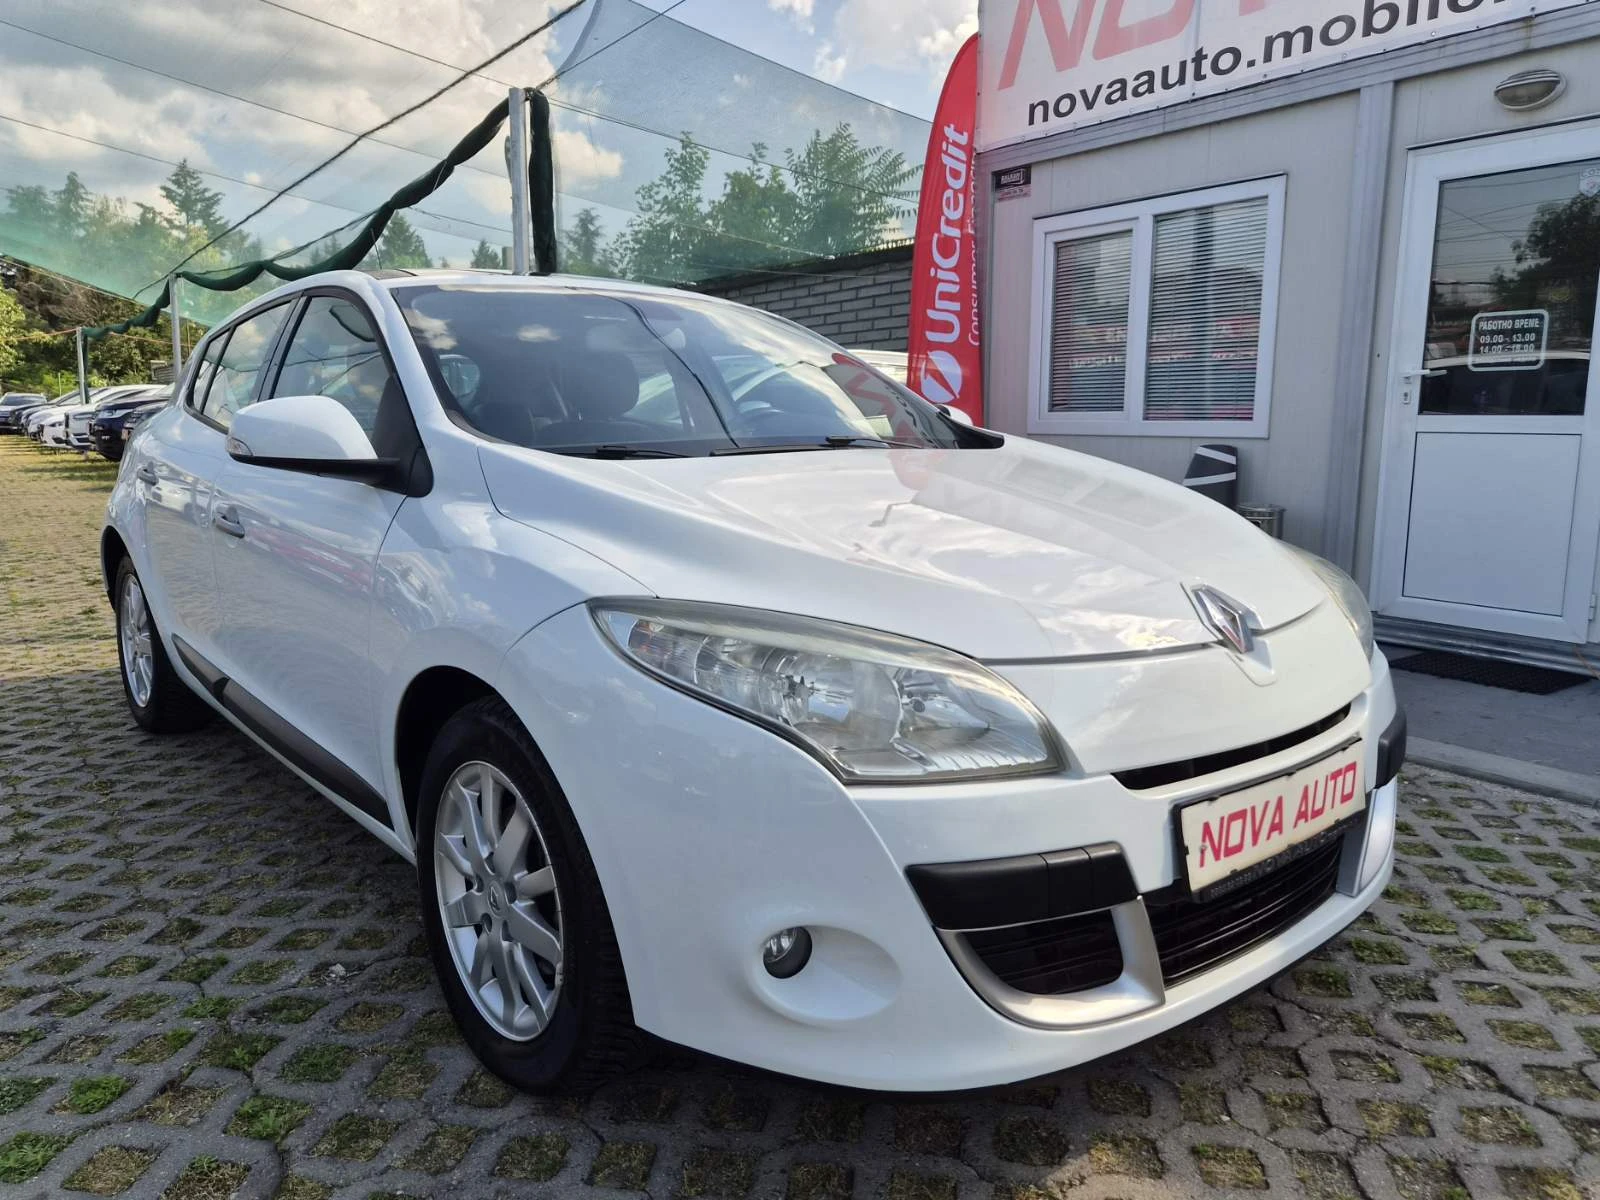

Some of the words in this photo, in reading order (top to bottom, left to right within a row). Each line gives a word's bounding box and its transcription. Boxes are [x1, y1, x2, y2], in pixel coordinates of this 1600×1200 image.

[925, 123, 969, 343] UniCredit
[1479, 320, 1512, 330] РАБОТНО
[1514, 318, 1540, 328] ВРЕМЕ
[1480, 334, 1504, 344] 09.00
[1199, 795, 1284, 869] NOVA
[1292, 761, 1357, 830] AUTO
